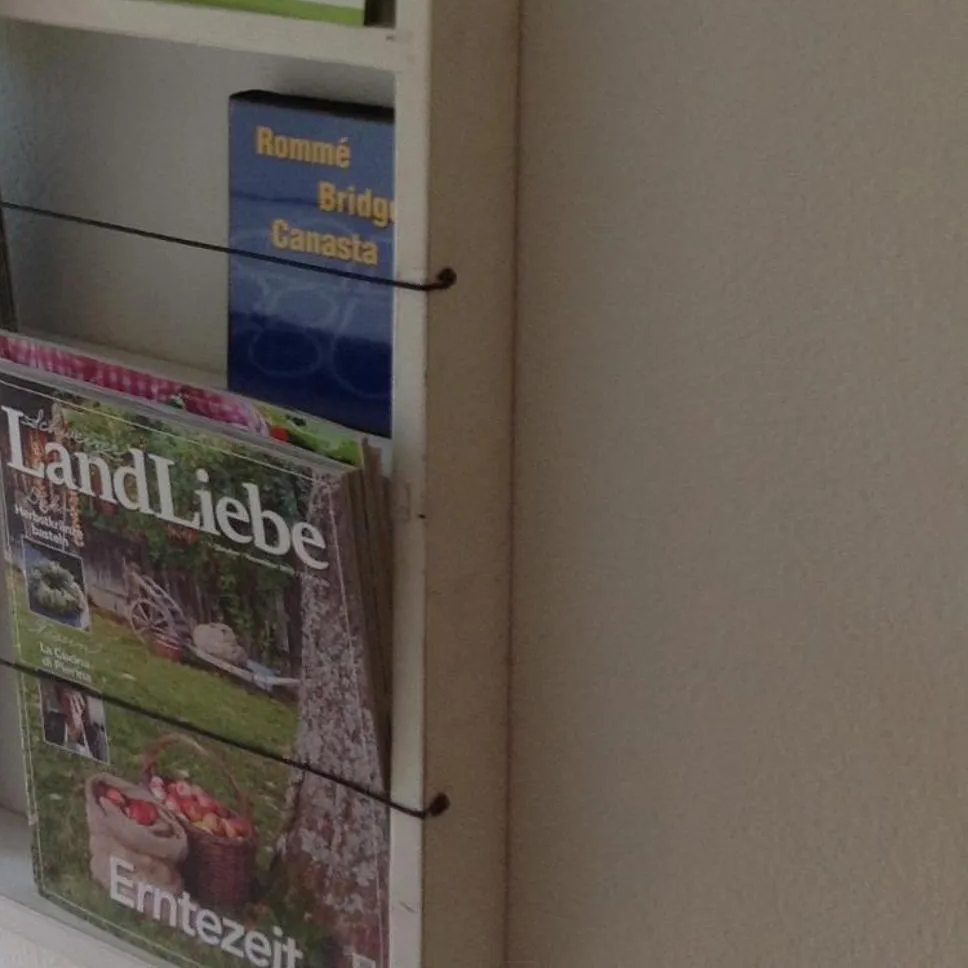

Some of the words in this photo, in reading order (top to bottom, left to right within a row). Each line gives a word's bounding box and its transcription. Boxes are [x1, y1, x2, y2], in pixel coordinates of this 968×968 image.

[255, 125, 351, 168] Rommé
[271, 218, 379, 266] Canasta
[0, 403, 330, 572] LandLiebe
[109, 855, 304, 968] Erntezeit
